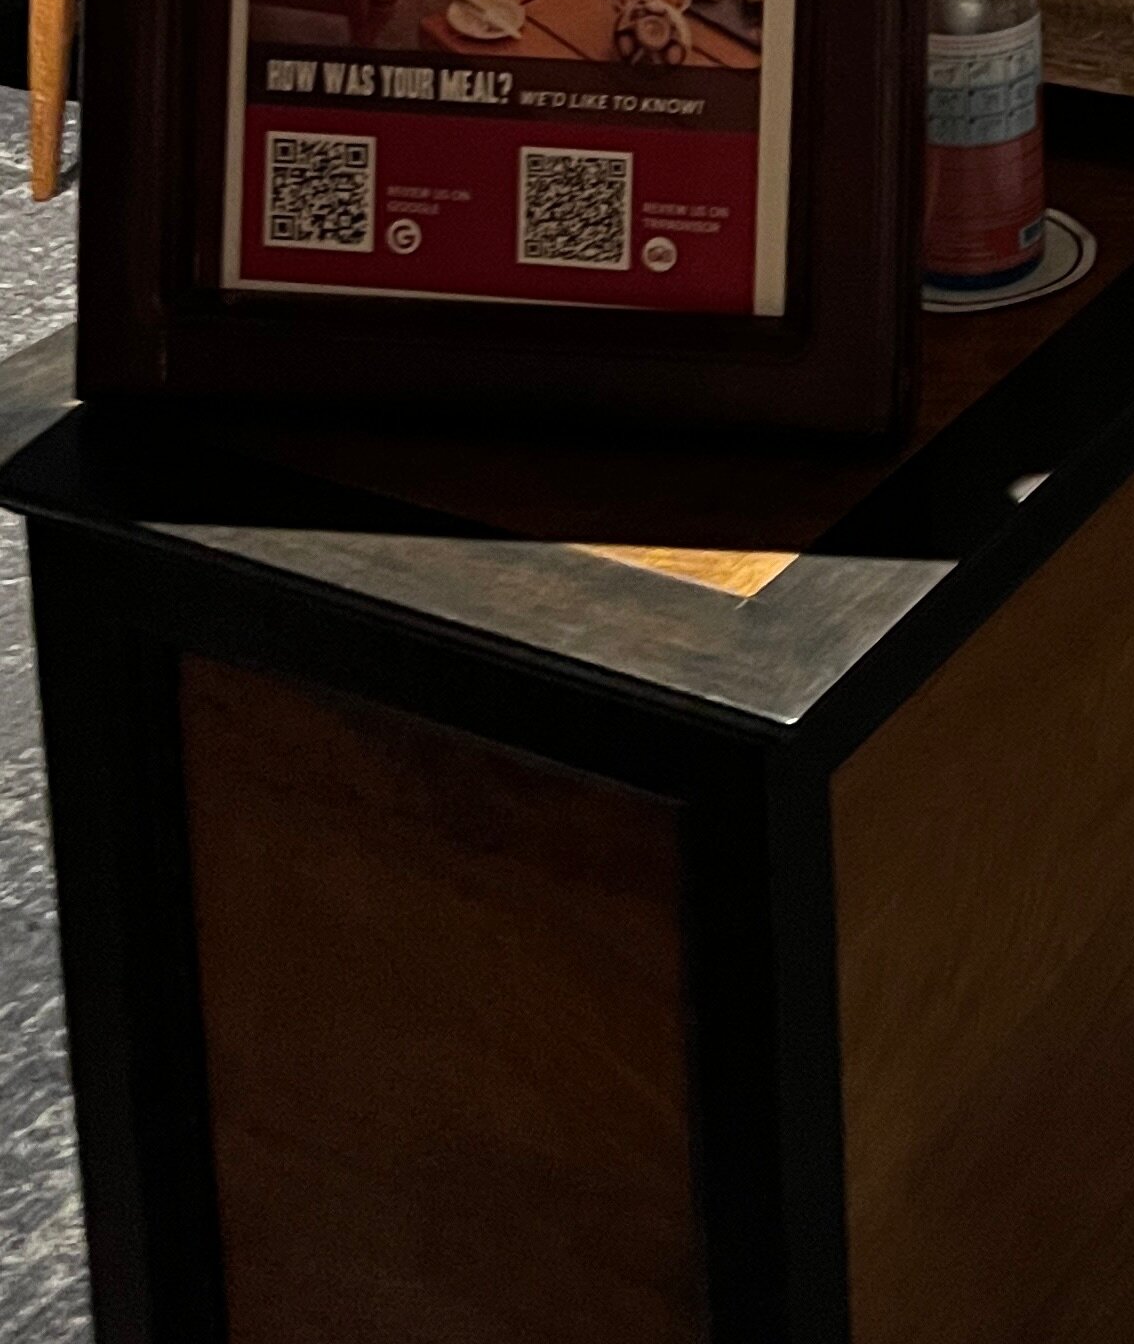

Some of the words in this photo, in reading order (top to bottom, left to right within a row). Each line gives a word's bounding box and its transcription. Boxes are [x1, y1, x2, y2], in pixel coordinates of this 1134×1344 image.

[266, 59, 318, 92] HOW
[322, 62, 375, 96] WAS
[379, 65, 435, 100] YOUR
[437, 68, 513, 105] MEAL?
[568, 93, 608, 109] LIKE
[612, 95, 638, 111] TO
[639, 97, 705, 114] KNOW!
